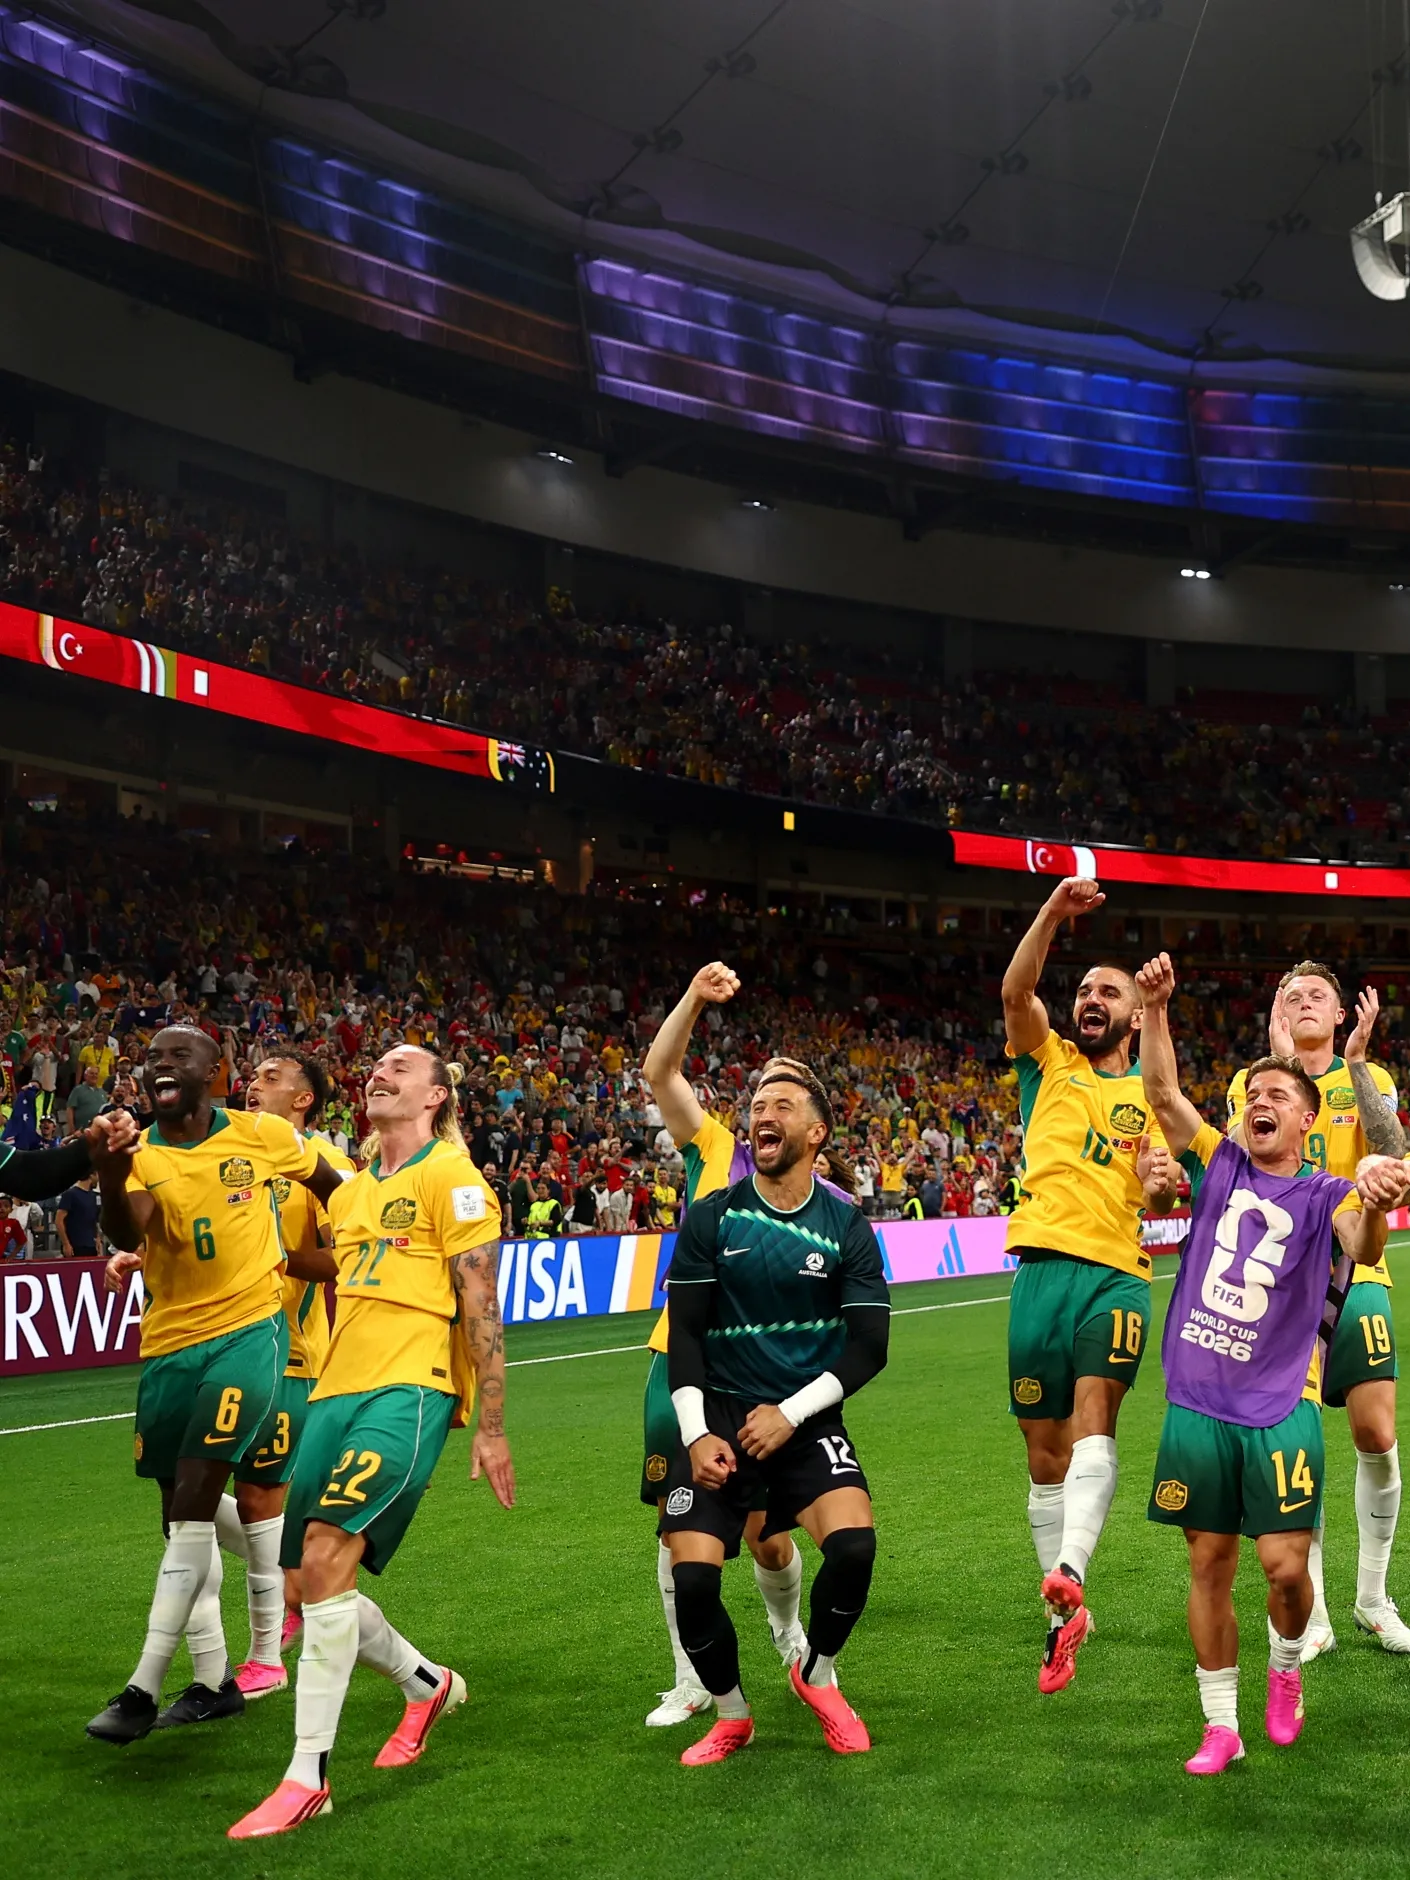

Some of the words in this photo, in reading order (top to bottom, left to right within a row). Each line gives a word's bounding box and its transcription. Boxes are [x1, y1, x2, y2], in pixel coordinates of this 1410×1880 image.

[193, 1217, 216, 1261] 6
[346, 1239, 388, 1286] 22
[798, 1269, 828, 1278] AUSTRALIA
[1212, 1284, 1244, 1310] FIFA
[1110, 1308, 1142, 1356] 16
[1180, 1321, 1253, 1362] 2026
[1189, 1307, 1228, 1332] WORLD
[1228, 1324, 1258, 1342] CUP
[1359, 1314, 1391, 1354] 19
[215, 1386, 243, 1433] 6
[256, 1412, 290, 1455] 3
[817, 1435, 859, 1467] 12
[327, 1449, 382, 1502] 22
[1271, 1448, 1315, 1497] 14
